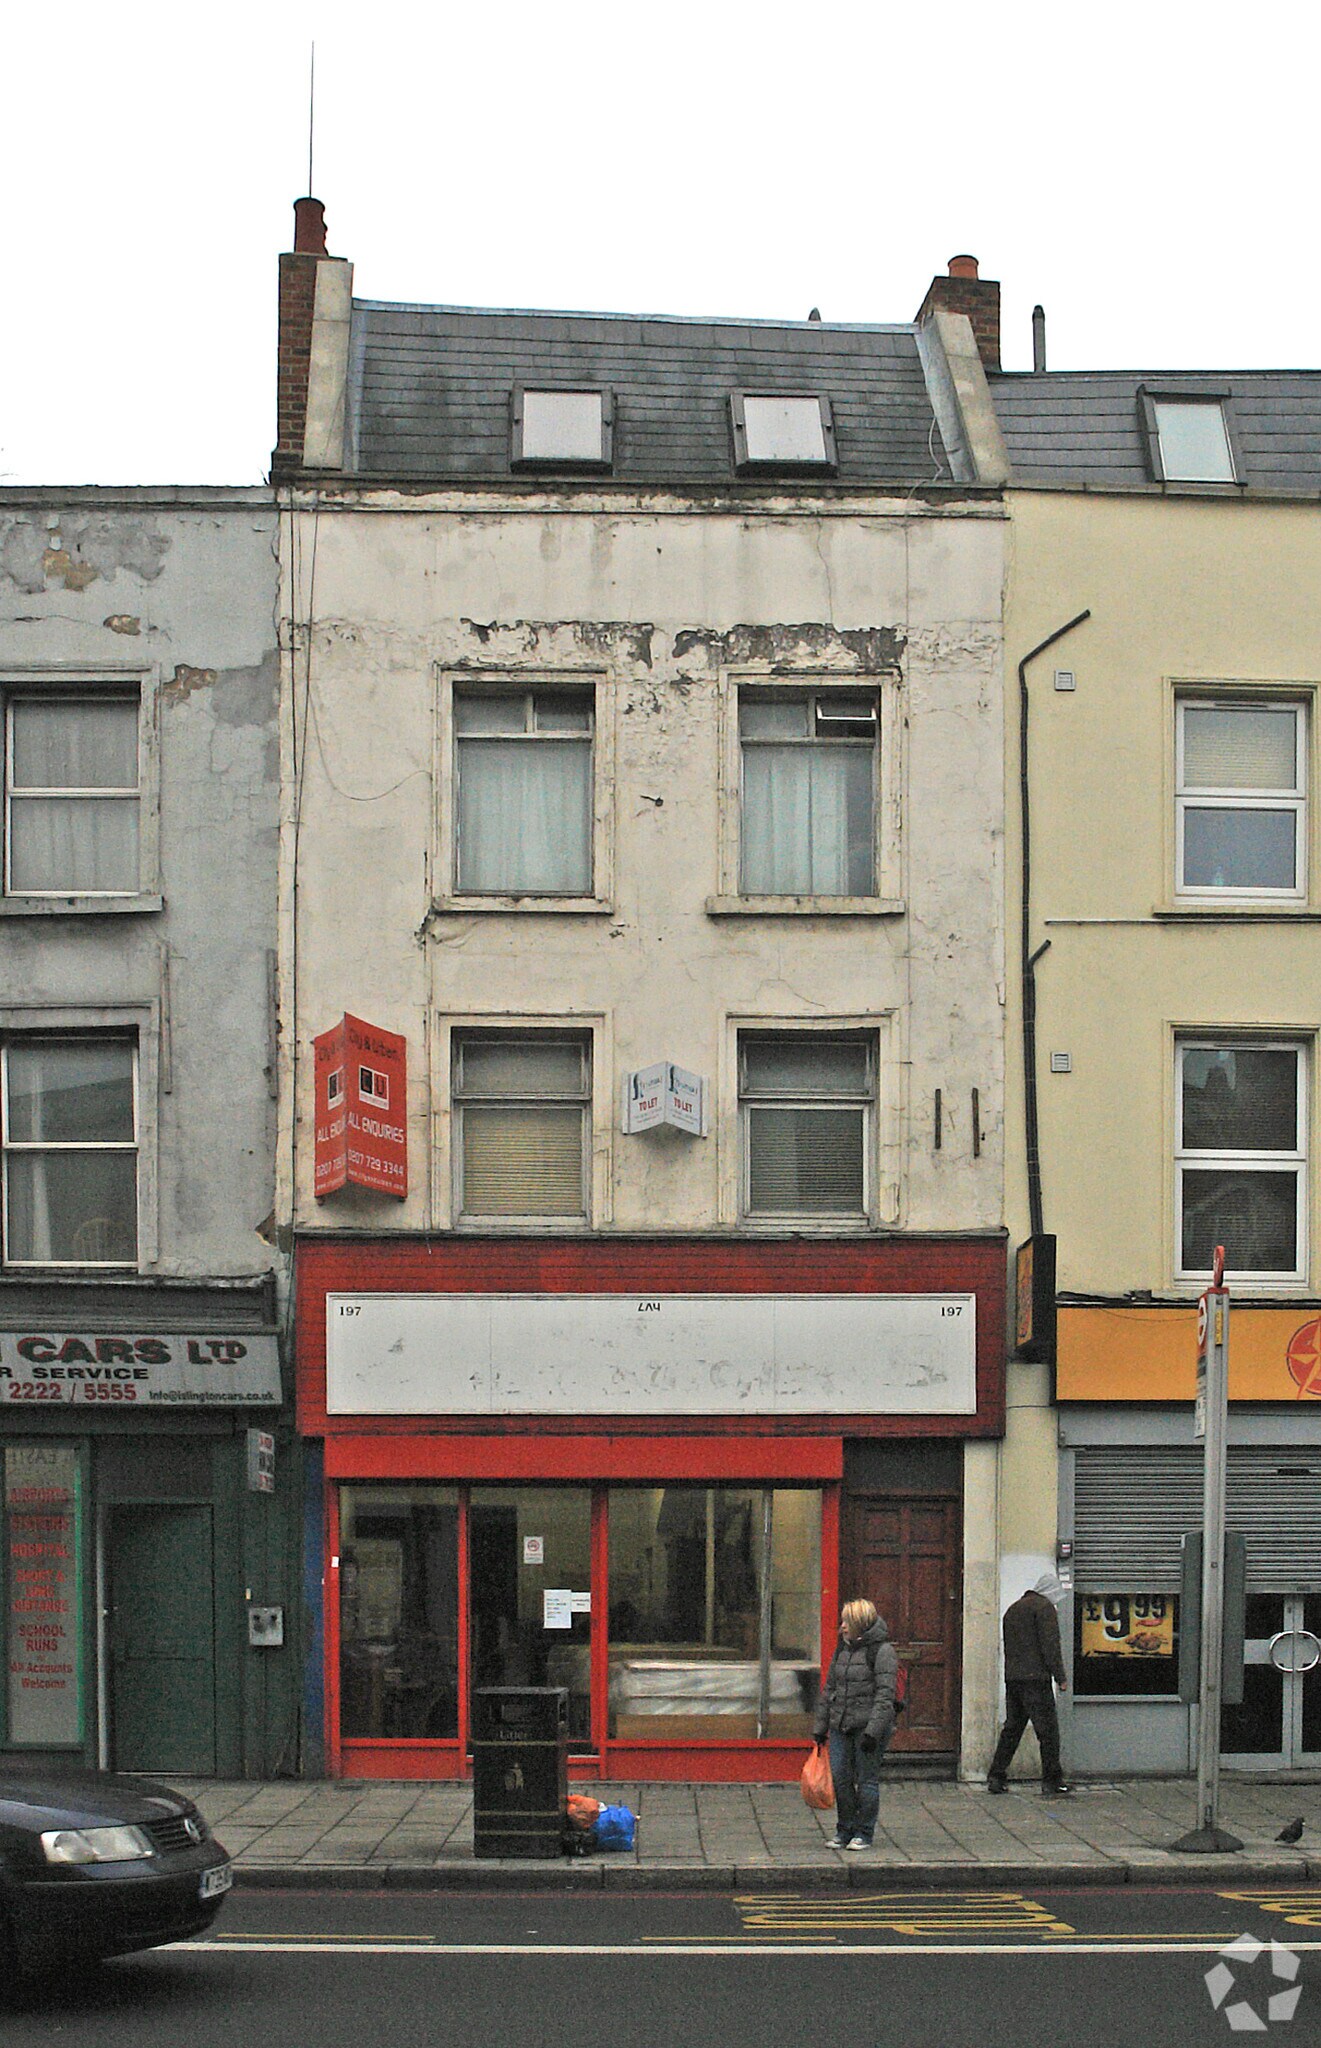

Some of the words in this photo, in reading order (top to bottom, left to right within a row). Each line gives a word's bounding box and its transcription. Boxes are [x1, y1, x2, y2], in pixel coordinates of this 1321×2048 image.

[347, 1111, 361, 1130] ALL
[361, 1116, 405, 1144] ENQUIRIES
[338, 1305, 362, 1316] 197
[940, 1306, 963, 1317] 197
[17, 1337, 172, 1364] CARS
[187, 1340, 248, 1365] LTD
[33, 1367, 149, 1380] SERVICE
[8, 1382, 63, 1400] 2222
[84, 1383, 138, 1401] 5555
[19, 1624, 66, 1637] SCHOOL
[26, 1639, 58, 1652] RUNS
